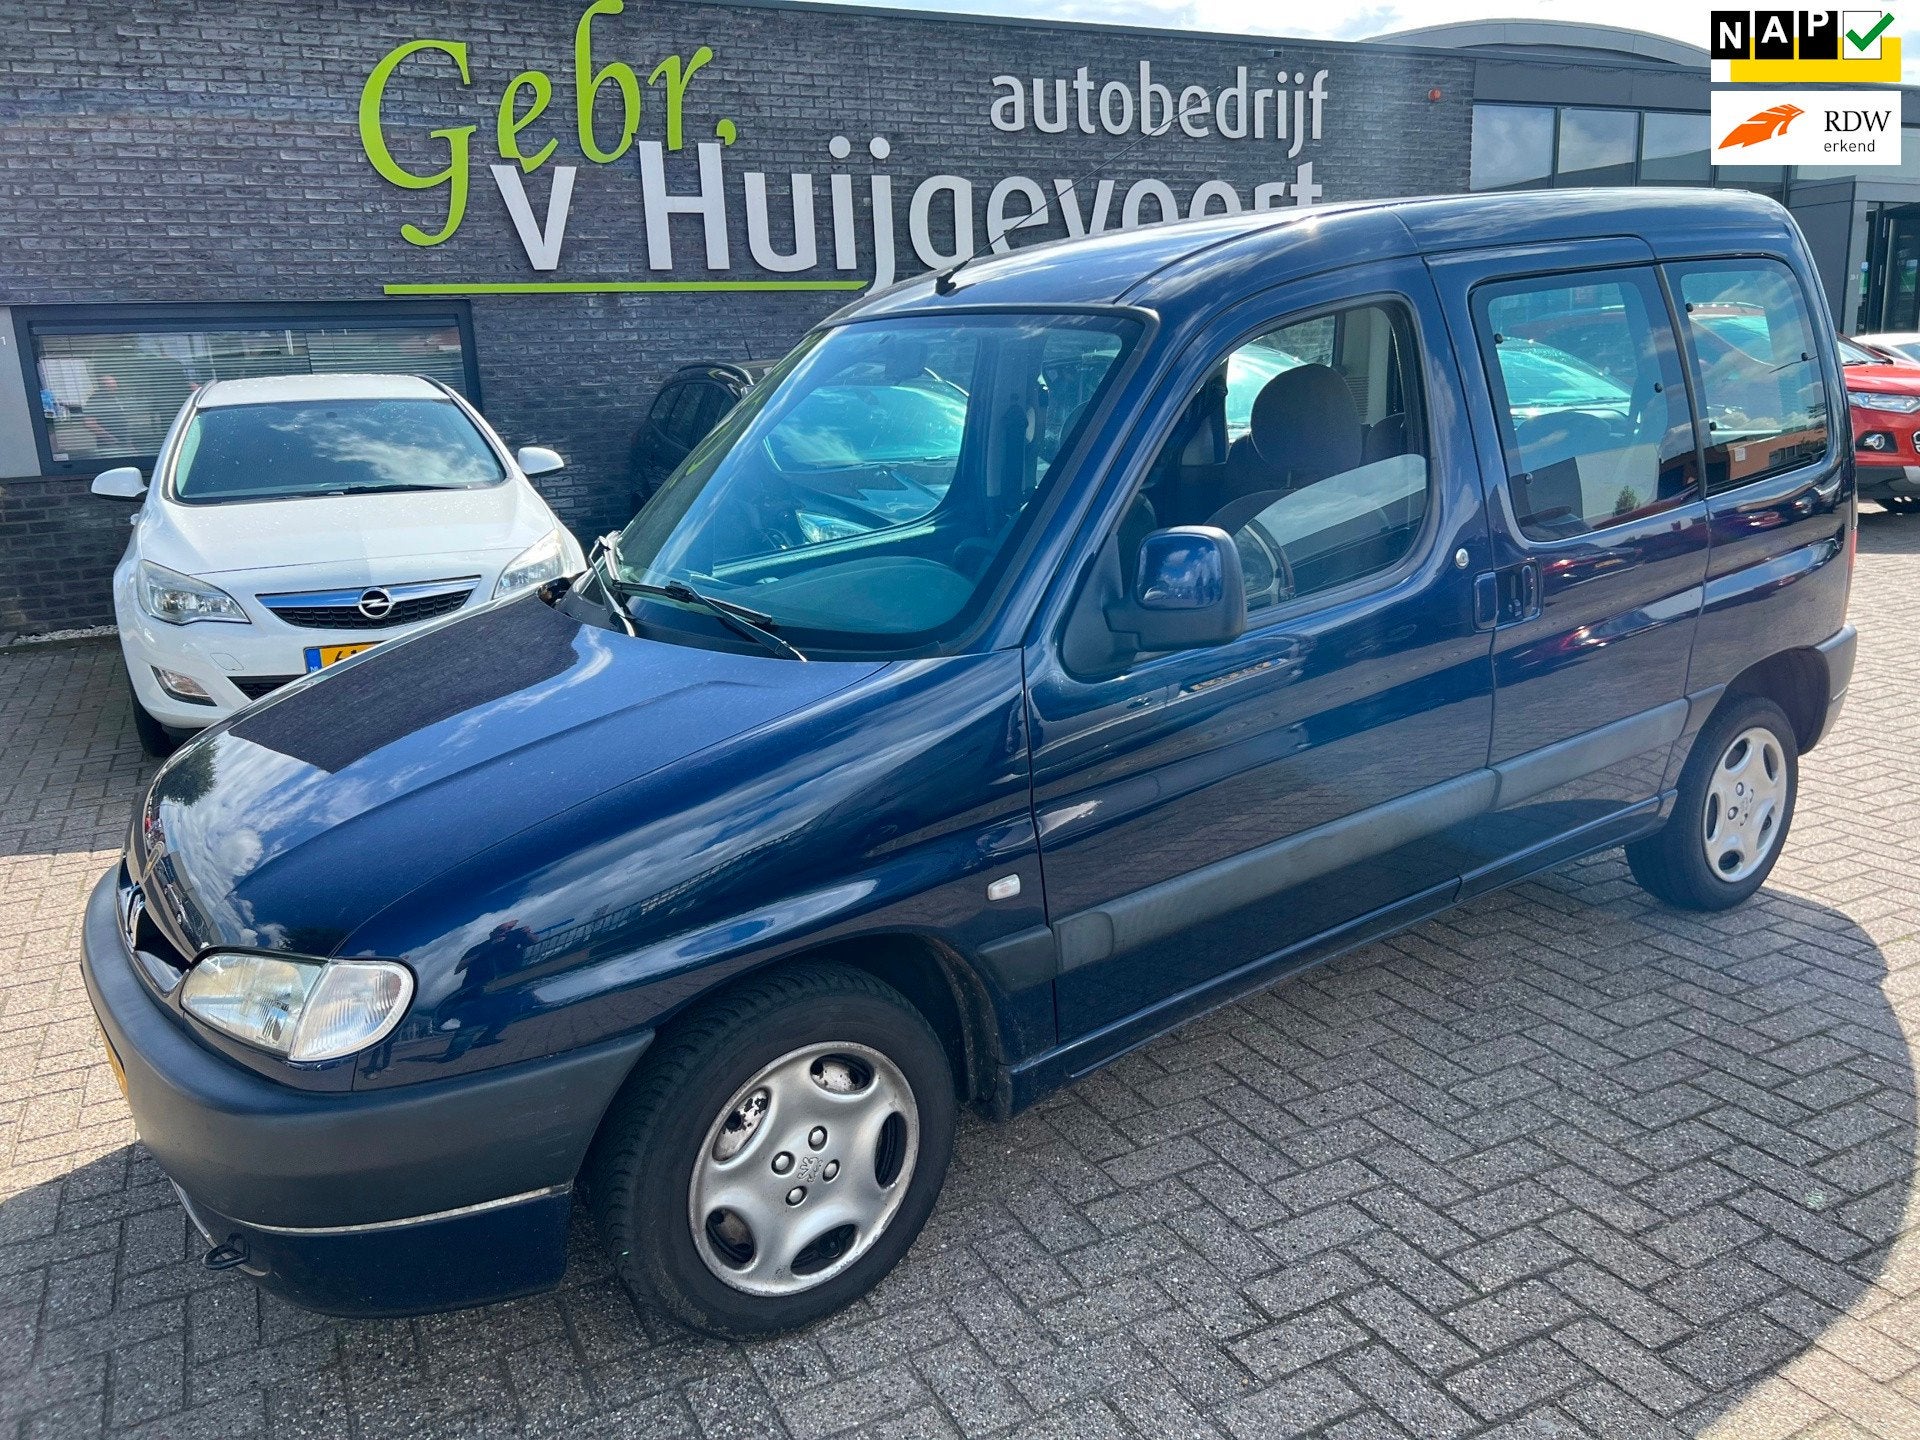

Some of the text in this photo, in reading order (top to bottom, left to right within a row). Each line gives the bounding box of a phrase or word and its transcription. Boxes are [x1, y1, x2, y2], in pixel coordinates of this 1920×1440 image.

[359, 0, 736, 246] Gebr.
[990, 61, 1329, 158] autobedrijf
[490, 165, 577, 271] v
